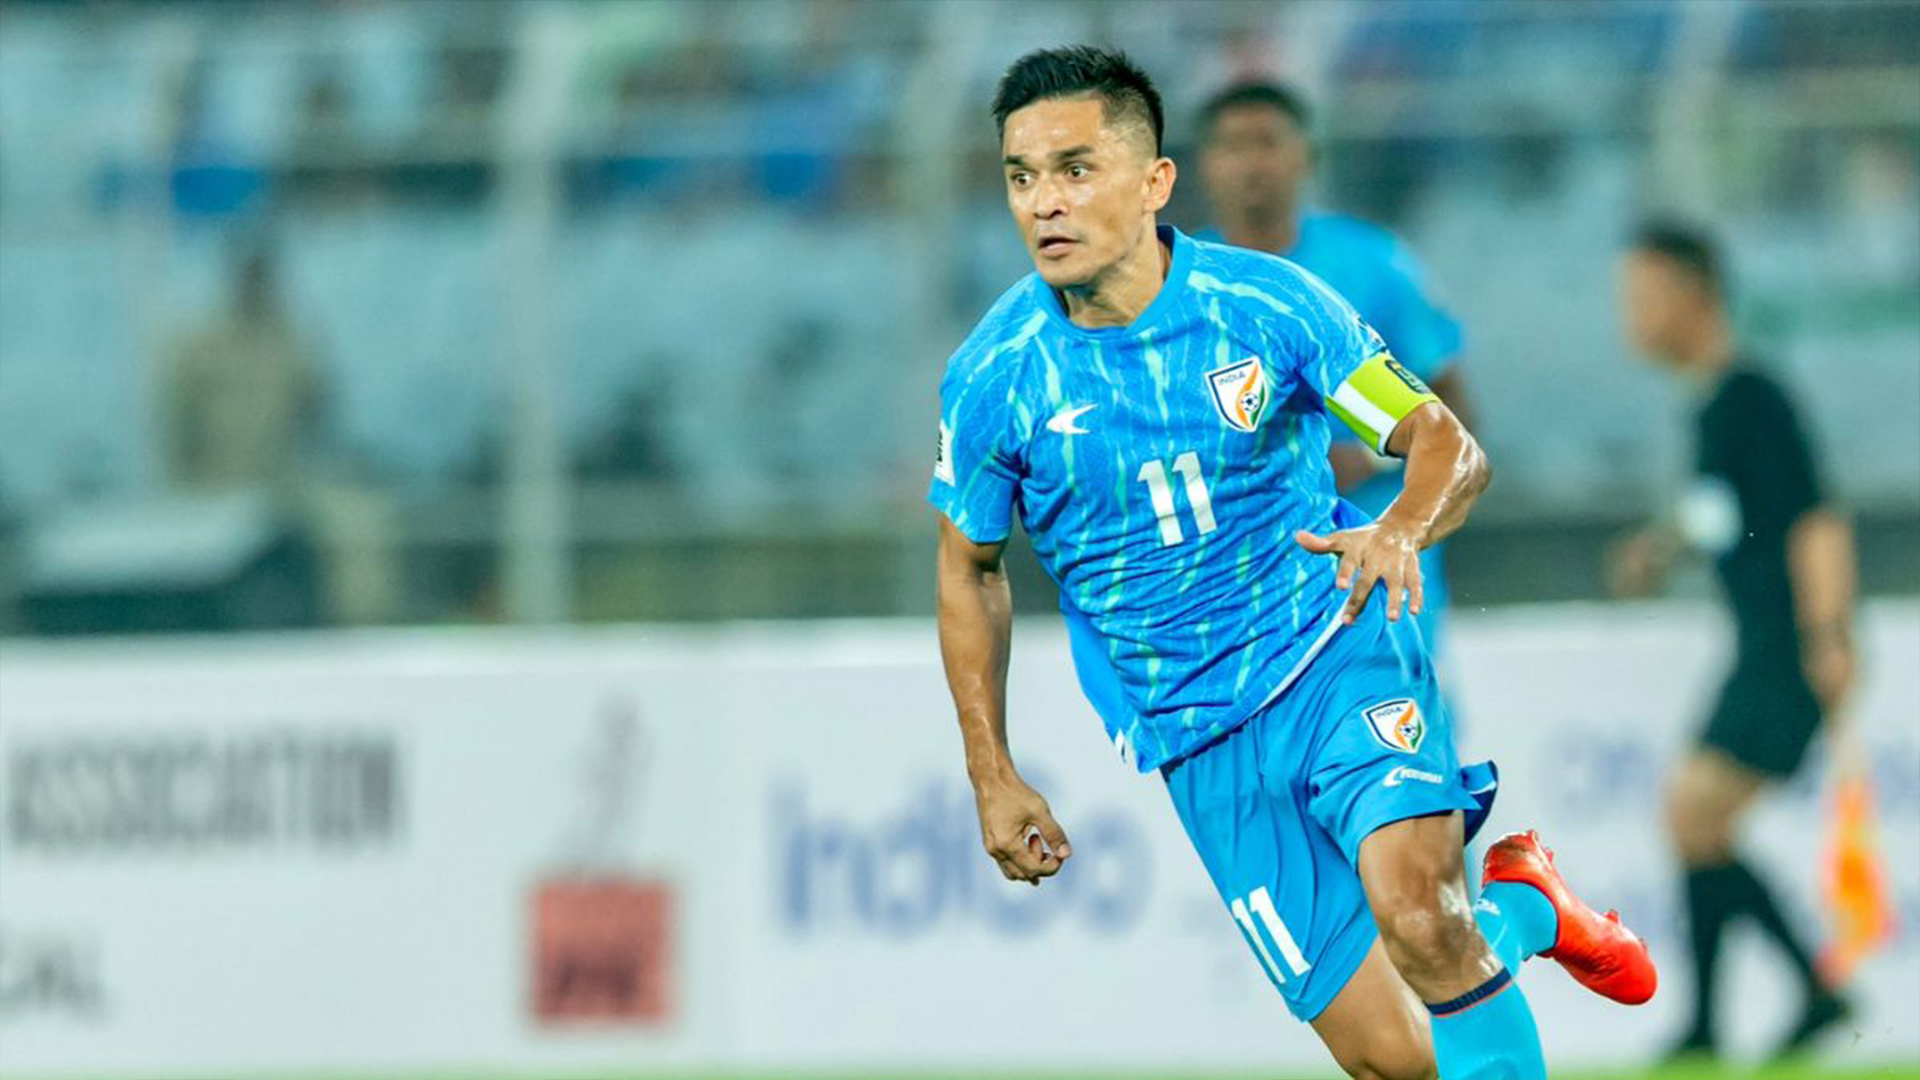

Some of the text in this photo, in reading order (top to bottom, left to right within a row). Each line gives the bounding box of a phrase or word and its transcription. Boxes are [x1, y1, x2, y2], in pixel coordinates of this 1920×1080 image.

[1218, 371, 1246, 385] INDIA
[1137, 451, 1217, 547] 11
[1375, 706, 1402, 718] INDIA
[1231, 885, 1312, 984] 11
